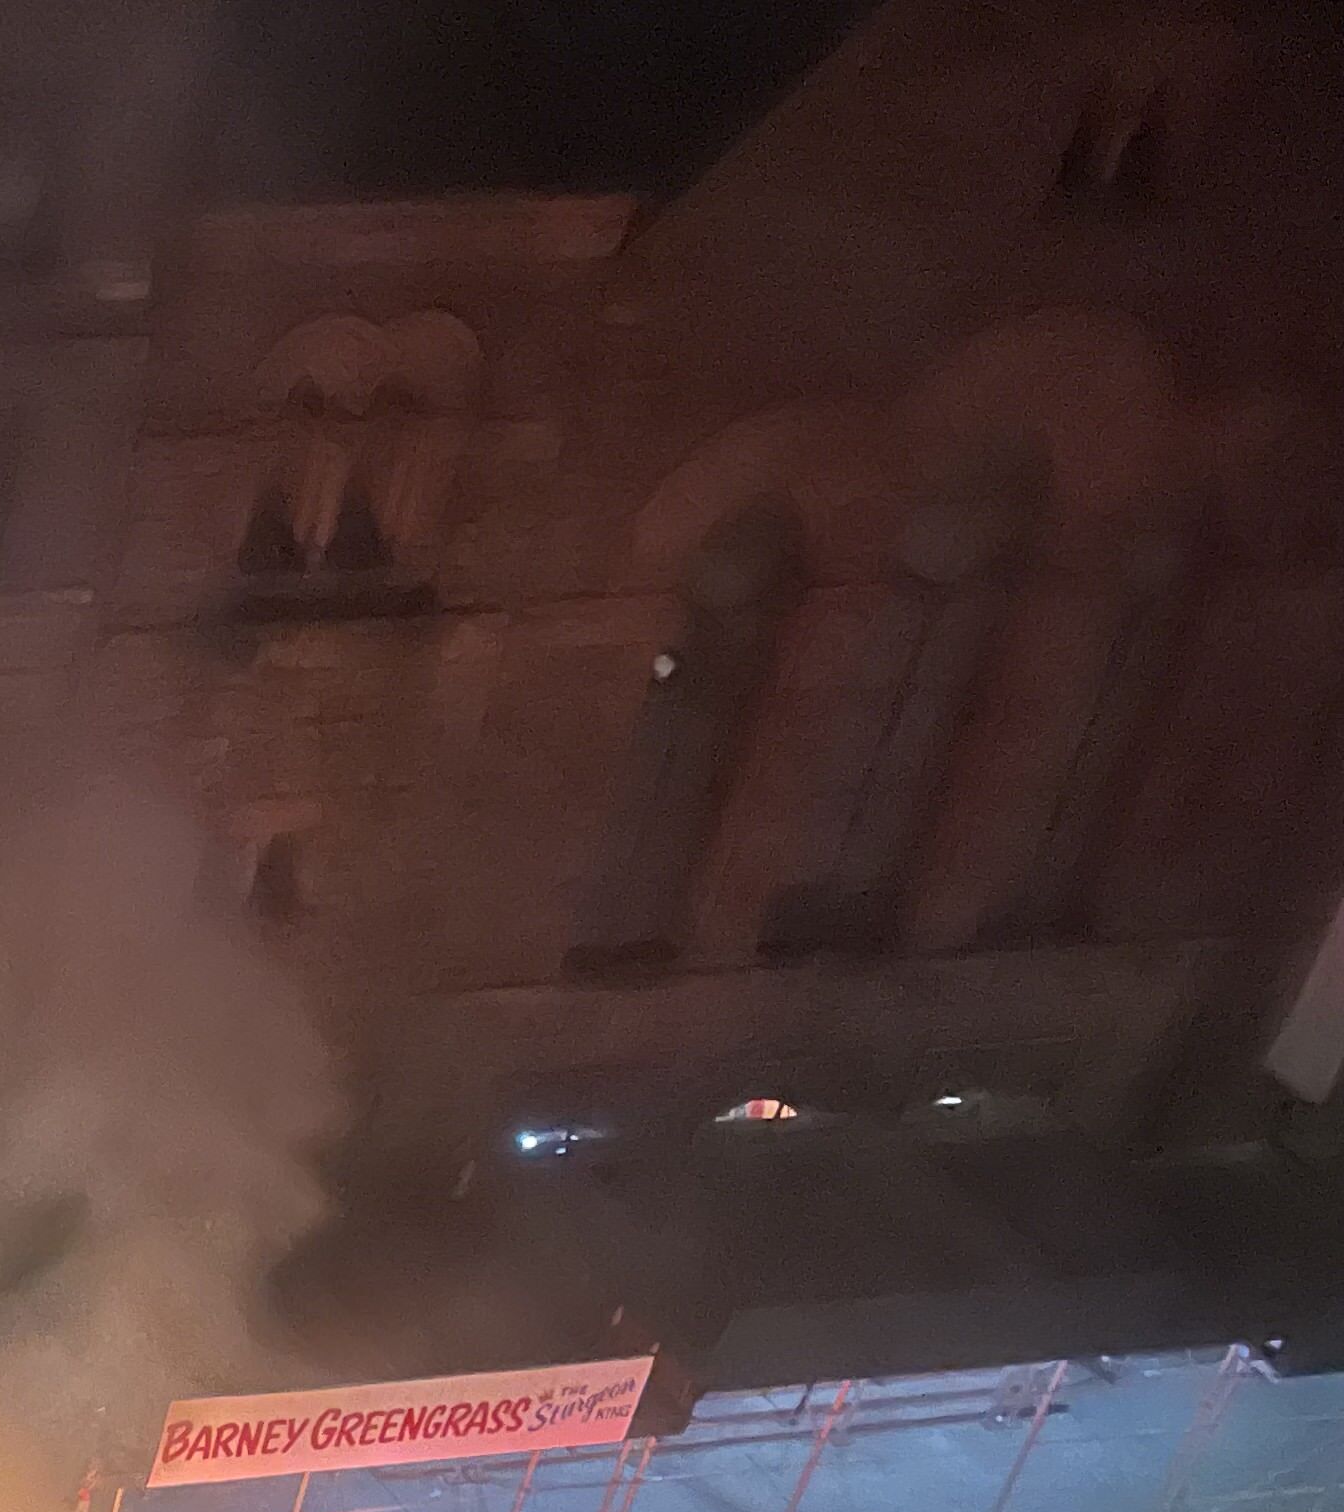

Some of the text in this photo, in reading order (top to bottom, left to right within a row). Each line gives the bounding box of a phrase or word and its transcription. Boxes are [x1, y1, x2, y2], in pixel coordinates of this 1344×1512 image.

[561, 1384, 589, 1396] THE
[160, 1378, 637, 1464] BARNEY GREENGRASS Sturgeon
